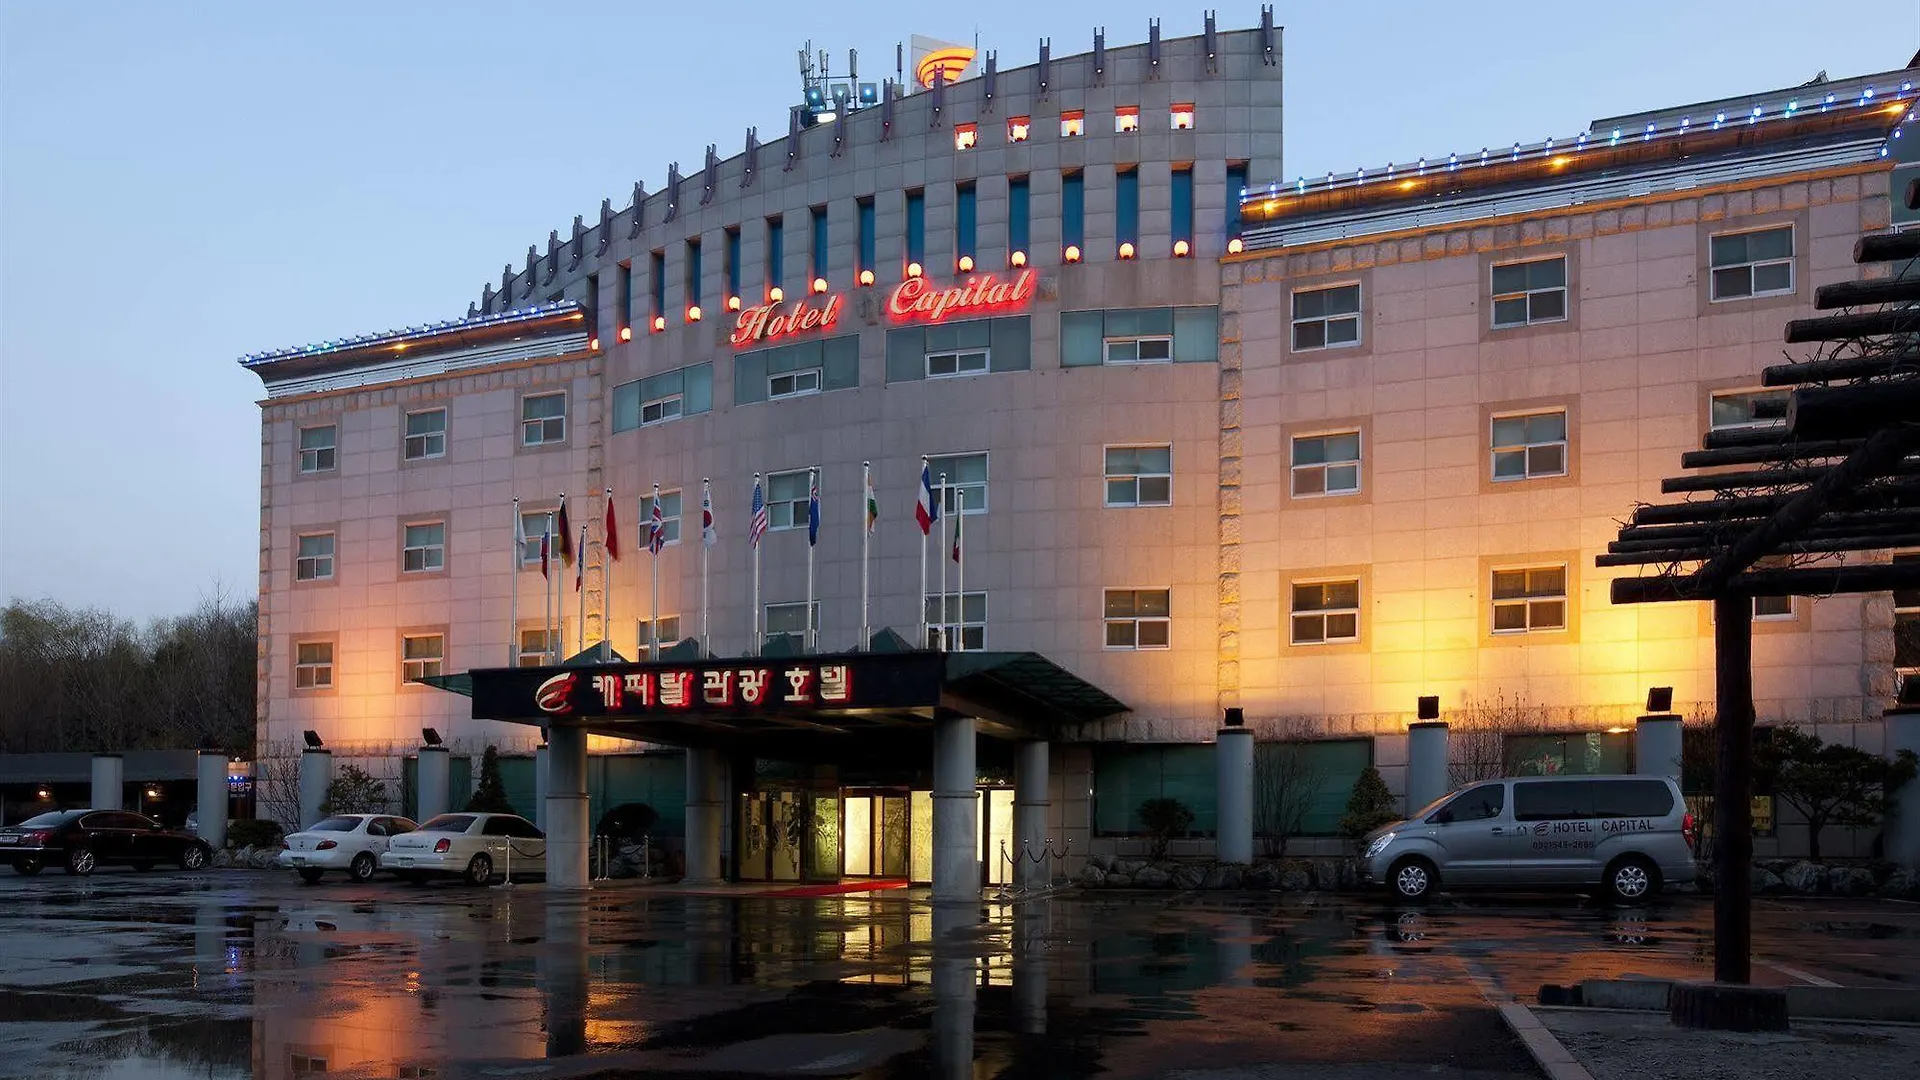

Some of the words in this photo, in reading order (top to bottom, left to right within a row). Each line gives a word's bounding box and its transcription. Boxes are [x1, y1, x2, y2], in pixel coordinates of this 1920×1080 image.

[730, 295, 839, 345] Hotel
[890, 269, 1032, 319] Capital
[703, 669, 768, 704] 관광
[784, 665, 847, 701] 호텔
[1553, 821, 1592, 833] HOTEL
[1601, 819, 1655, 832] CAPITAL
